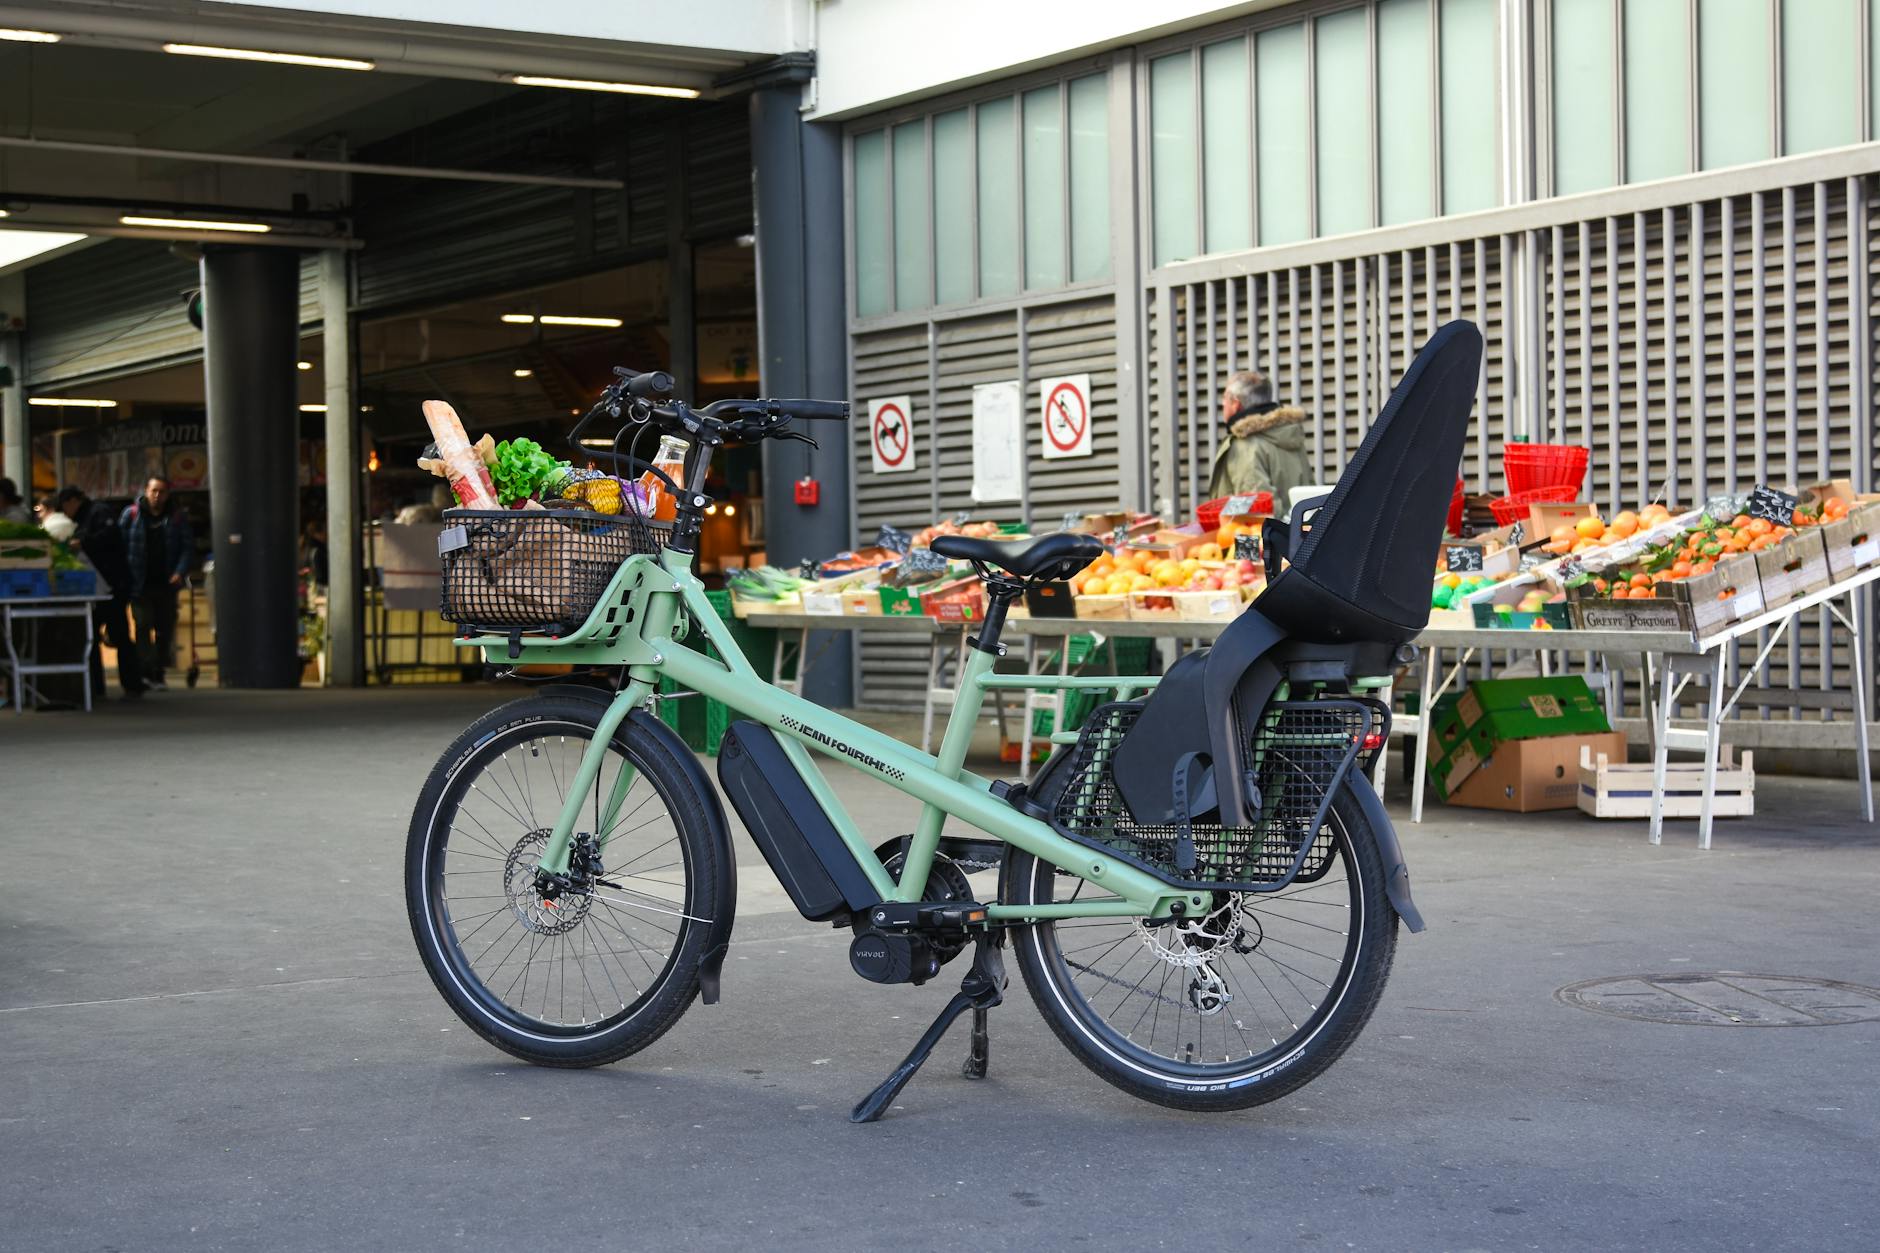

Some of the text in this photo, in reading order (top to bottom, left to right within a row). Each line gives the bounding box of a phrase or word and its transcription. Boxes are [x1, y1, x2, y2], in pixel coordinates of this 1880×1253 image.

[799, 723, 886, 772] JEAN FOURCHE
[1209, 1083, 1226, 1092] BIG
